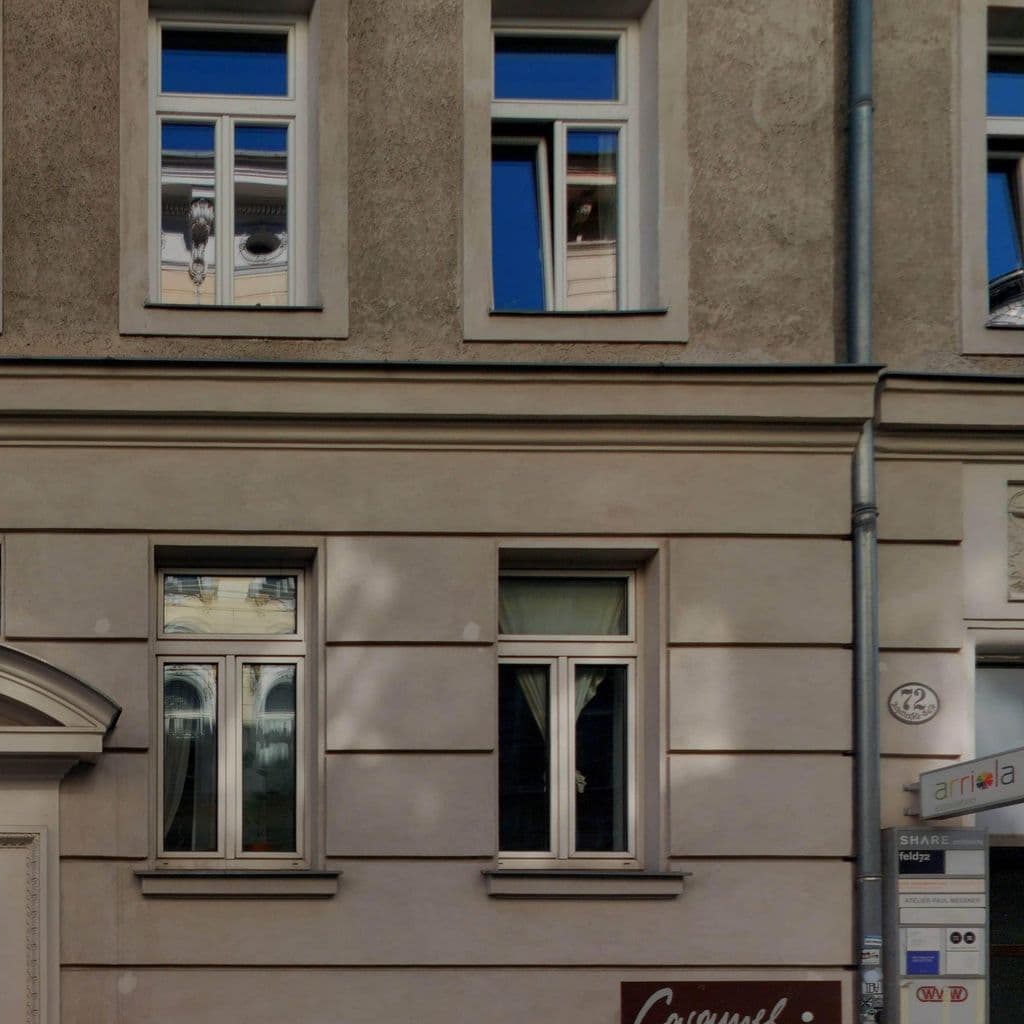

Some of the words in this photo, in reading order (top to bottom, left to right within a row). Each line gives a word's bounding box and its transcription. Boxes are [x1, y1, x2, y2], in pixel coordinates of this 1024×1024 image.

[901, 688, 926, 710] 72
[899, 835, 950, 846] SHARE
[899, 852, 930, 863] feld72
